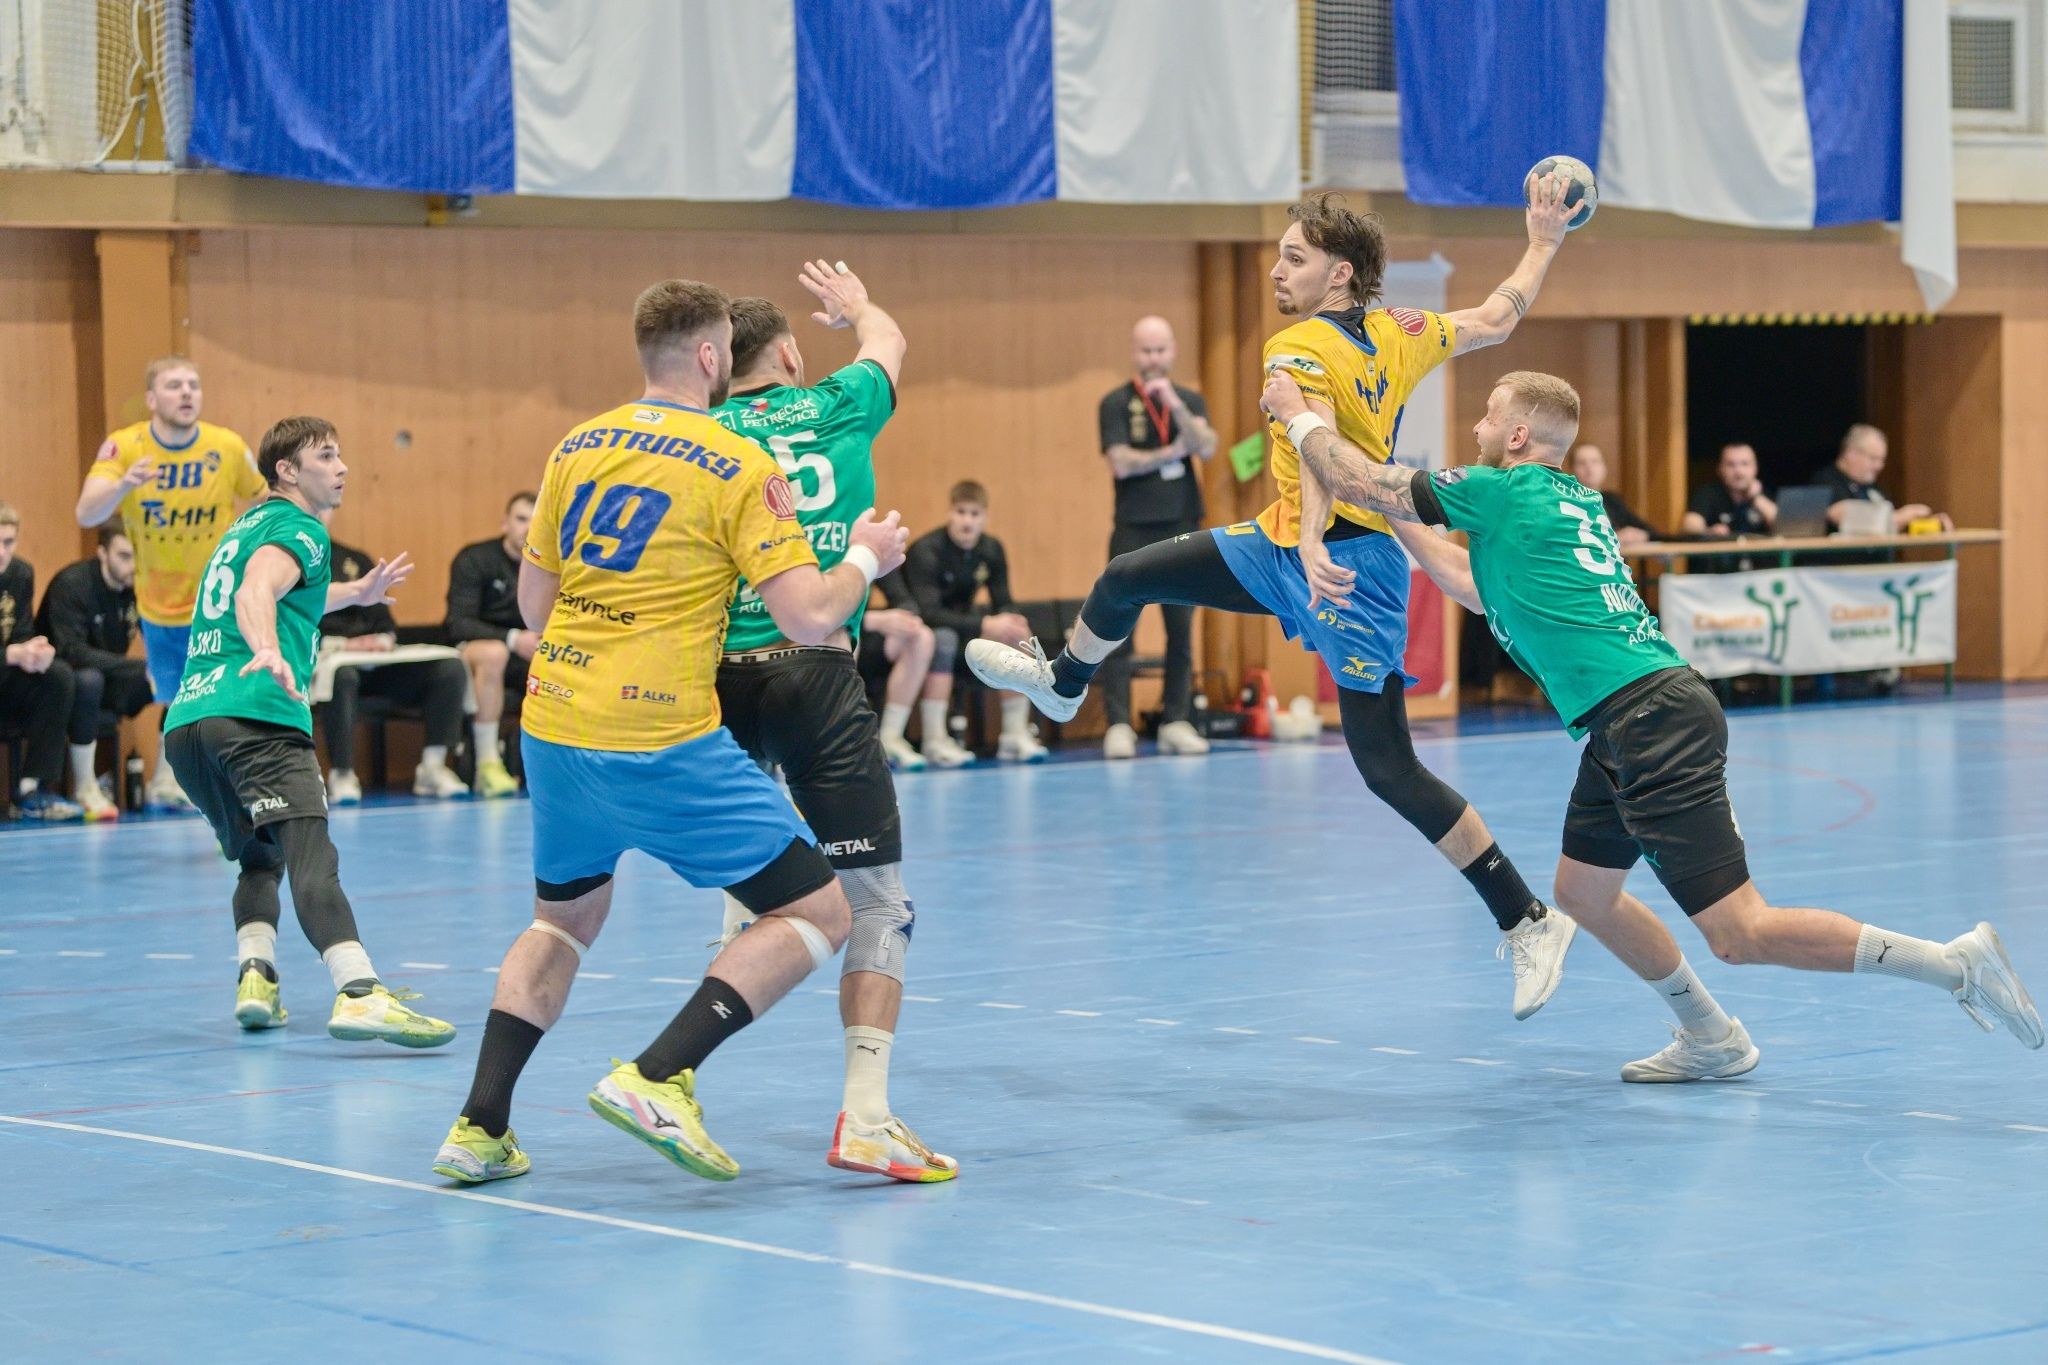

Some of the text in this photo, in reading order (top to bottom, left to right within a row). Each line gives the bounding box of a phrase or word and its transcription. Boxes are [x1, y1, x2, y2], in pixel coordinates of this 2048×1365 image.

[157, 462, 203, 490] 98
[766, 429, 837, 512] 5
[559, 479, 672, 573] 19
[201, 538, 240, 620] 6
[541, 681, 575, 699] TEPLO
[642, 690, 677, 704] ALKH
